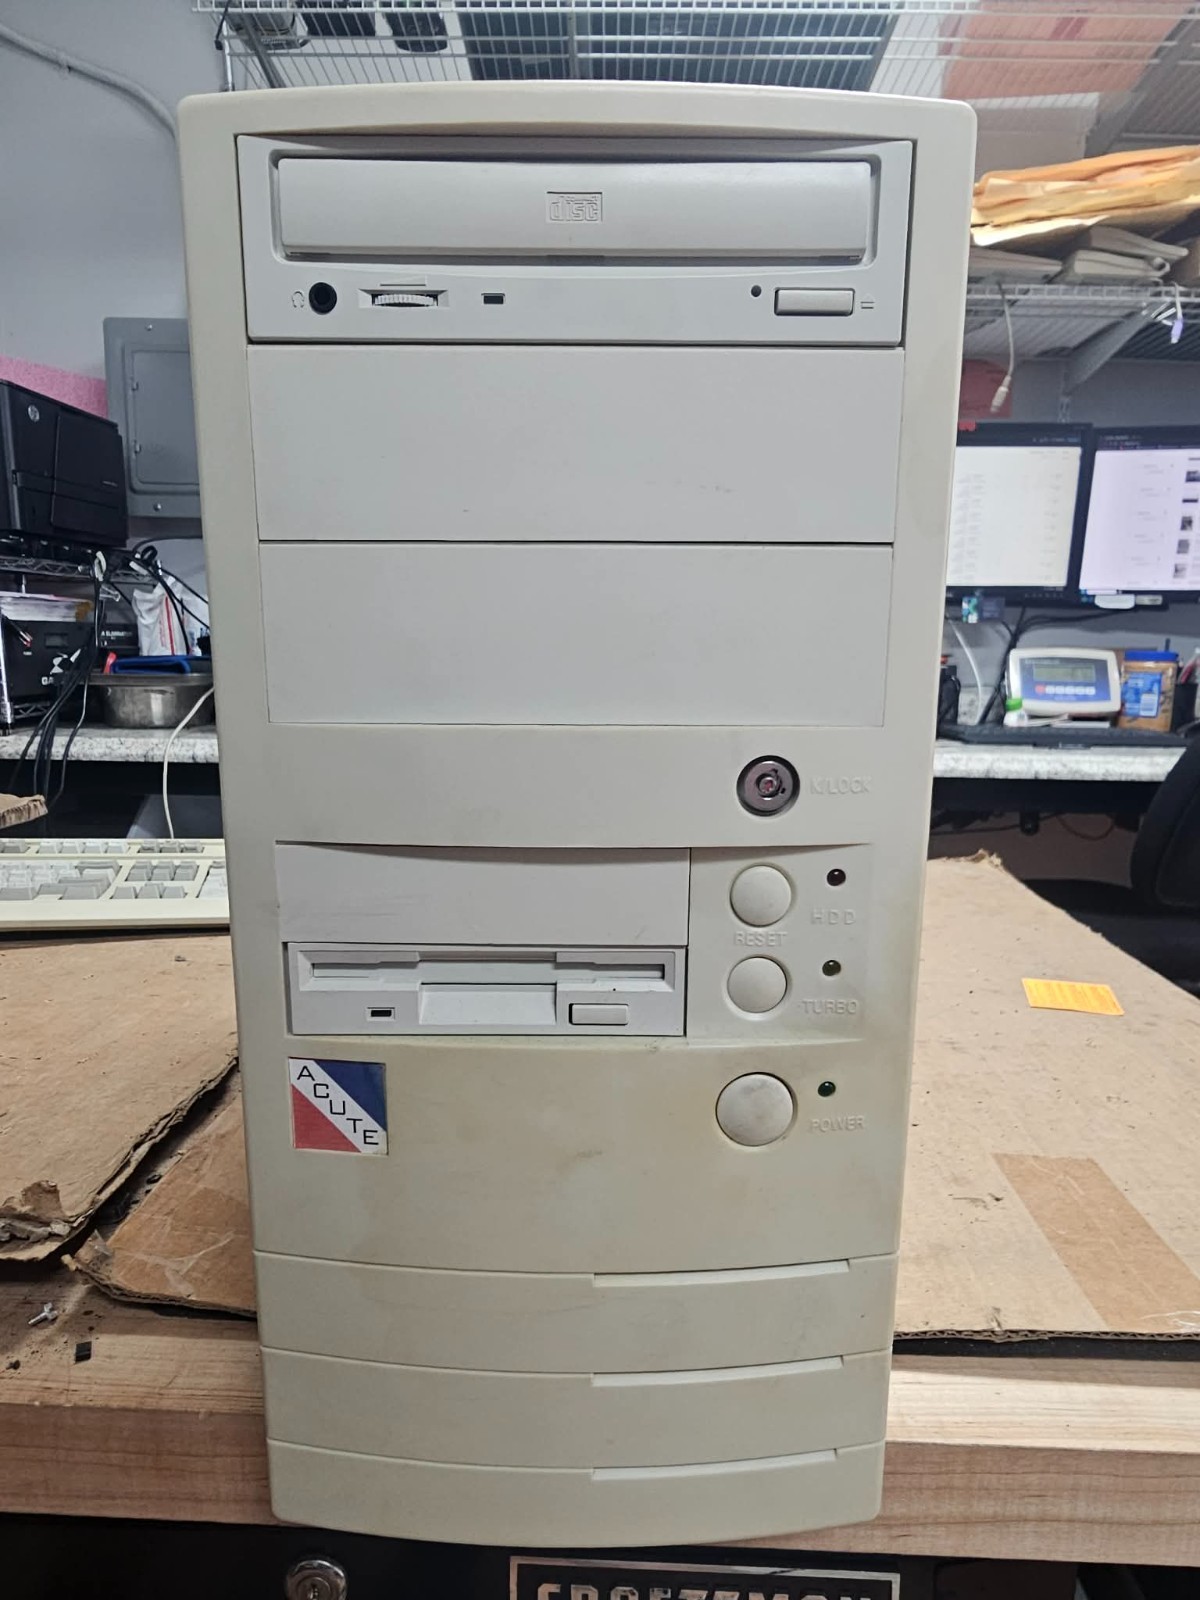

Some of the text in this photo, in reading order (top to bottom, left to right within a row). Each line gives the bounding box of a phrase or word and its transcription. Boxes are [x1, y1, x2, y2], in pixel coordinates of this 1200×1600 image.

[810, 908, 857, 926] HDD
[734, 931, 788, 947] RESET
[802, 998, 859, 1015] TURBO
[296, 1065, 379, 1146] ACUTE
[809, 1115, 865, 1133] POWER
